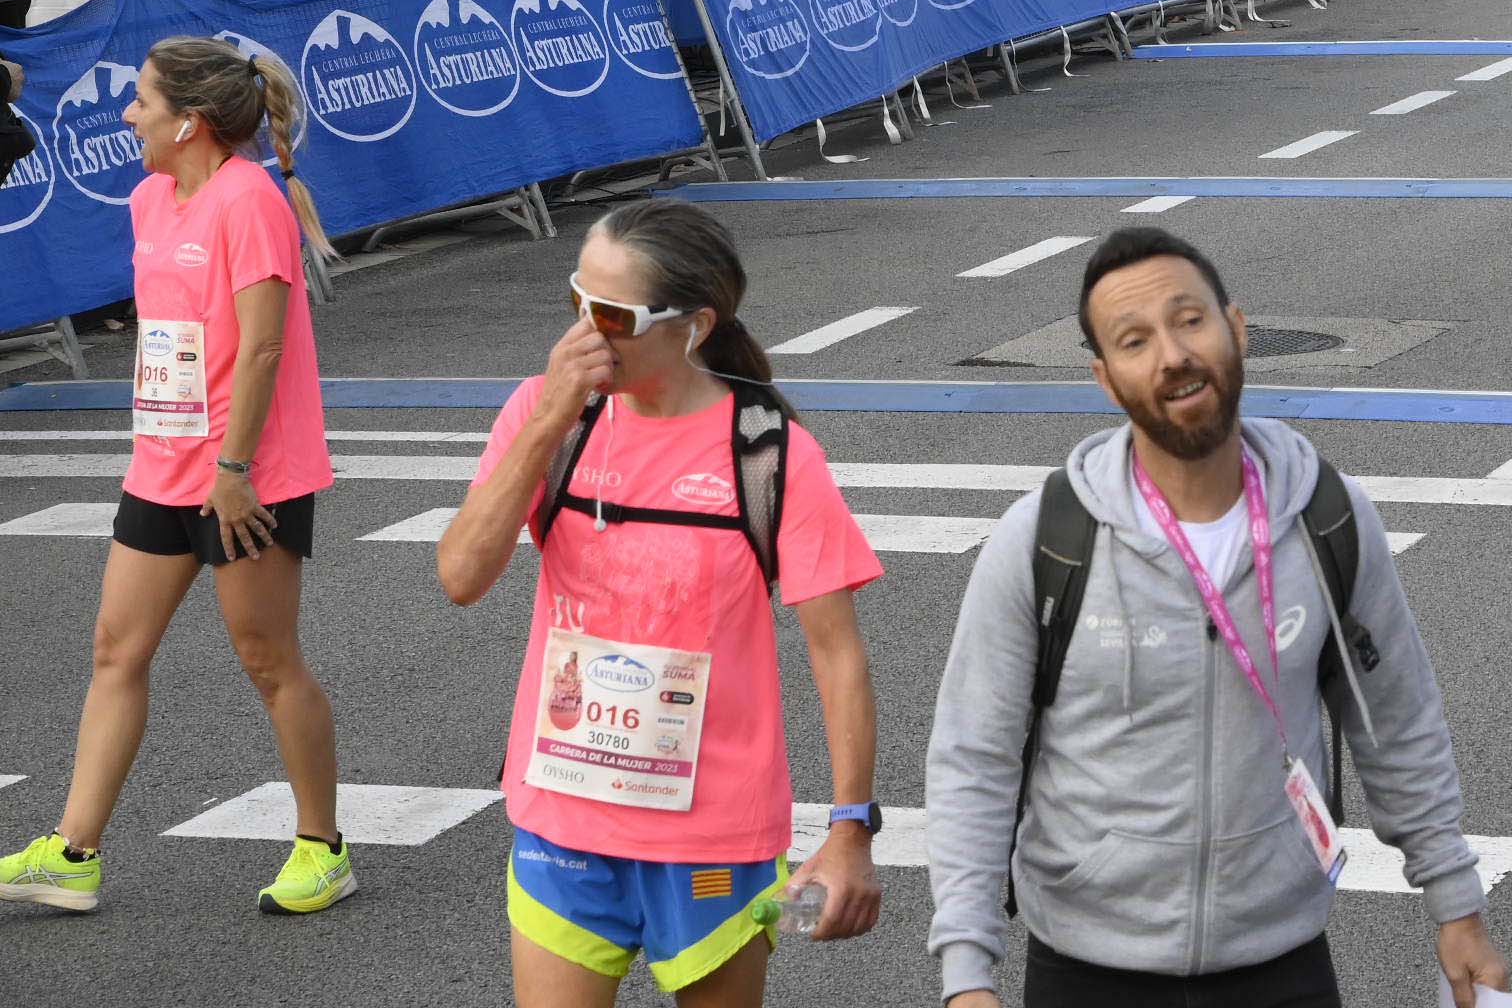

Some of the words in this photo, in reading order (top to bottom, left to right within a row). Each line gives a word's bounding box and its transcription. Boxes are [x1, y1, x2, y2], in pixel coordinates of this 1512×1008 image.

[622, 3, 653, 18] CENTRAL
[527, 18, 558, 35] CENTRAL
[557, 14, 589, 30] LECHERA
[613, 12, 673, 56] ASTUR
[434, 33, 468, 50] CENTRAL
[468, 29, 501, 44] LECHERA
[519, 26, 605, 72] ASTURIANA
[322, 55, 360, 73] CENTRAL
[360, 48, 397, 65] LECHERA
[424, 42, 516, 90] ASTURIANA
[311, 65, 412, 115] ASTURIANA
[76, 110, 120, 130] CENTRAL
[144, 365, 169, 383] 016
[573, 465, 622, 488] YSHO
[590, 664, 649, 689] ASTURIANA
[662, 669, 696, 682] SUMA
[586, 701, 641, 730] 016
[587, 730, 630, 751] 30780
[549, 743, 588, 761] CARRERA
[589, 752, 602, 764] DE
[602, 754, 615, 766] LA
[616, 756, 653, 771] MUJER
[543, 765, 585, 784] OYSHO
[624, 780, 679, 797] Santander
